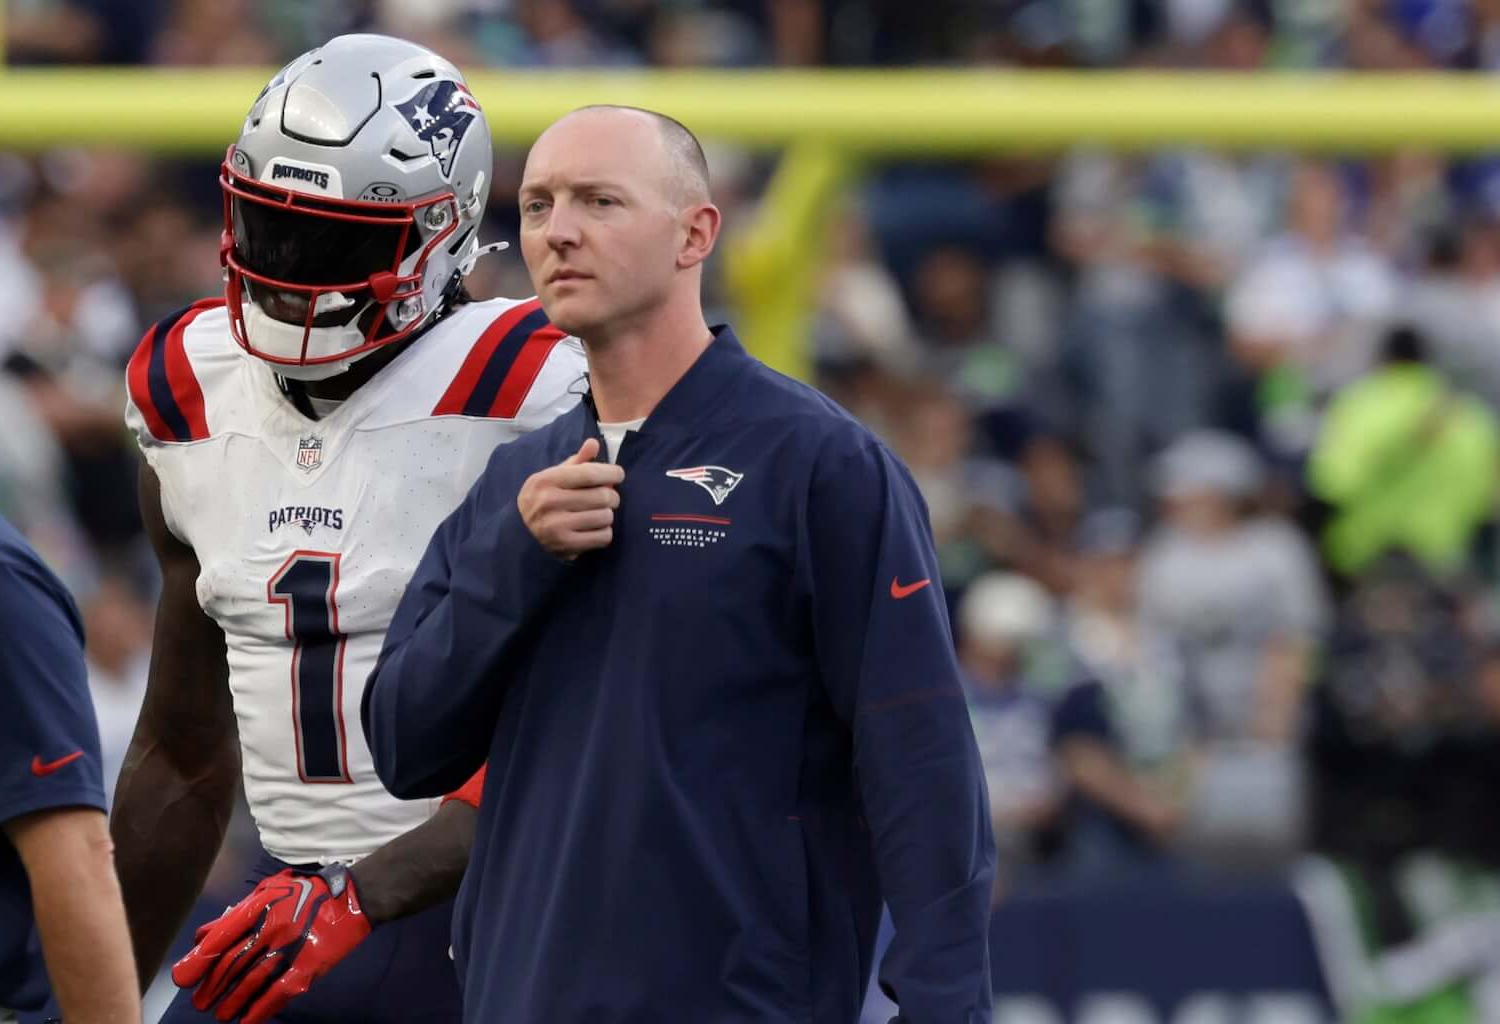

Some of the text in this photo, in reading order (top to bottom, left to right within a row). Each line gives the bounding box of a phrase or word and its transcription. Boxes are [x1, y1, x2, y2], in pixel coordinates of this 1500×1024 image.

[271, 163, 330, 190] PATRIOTS
[299, 450, 319, 465] NFL
[269, 505, 343, 533] PATRIOTS
[267, 549, 356, 784] 1
